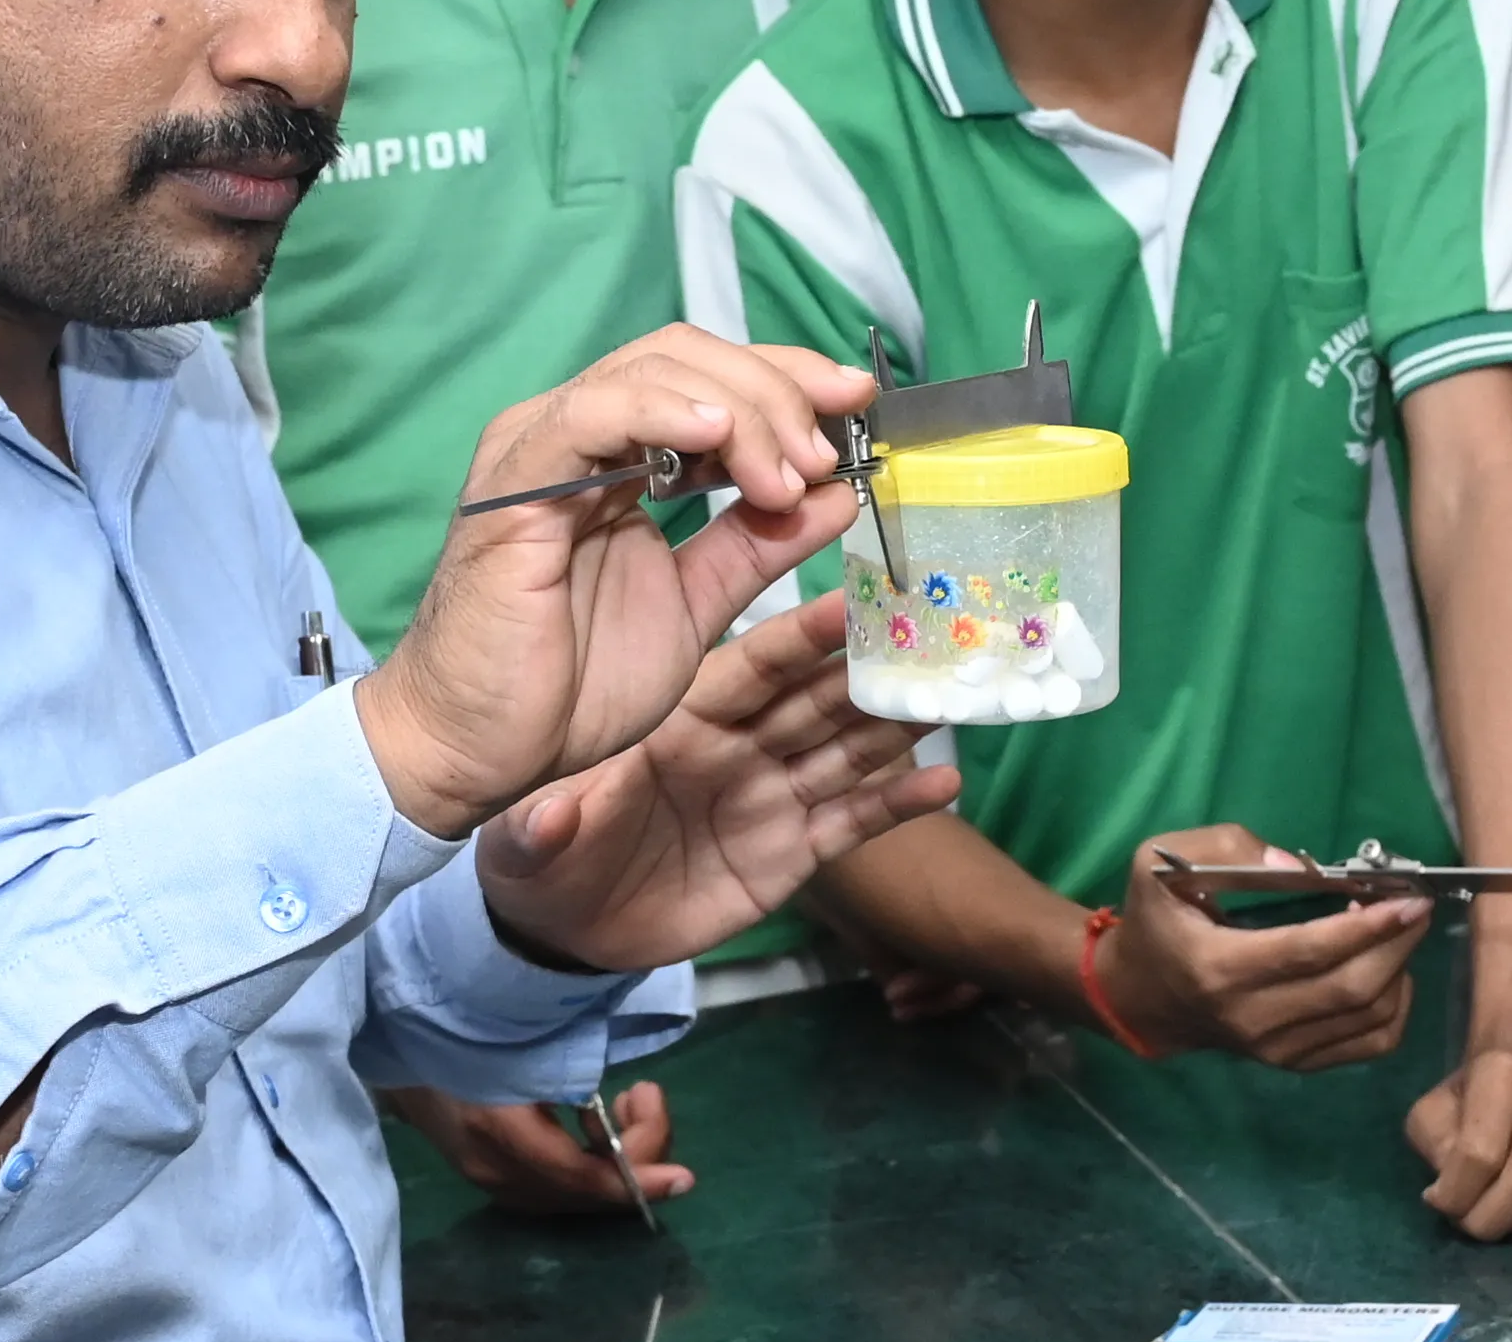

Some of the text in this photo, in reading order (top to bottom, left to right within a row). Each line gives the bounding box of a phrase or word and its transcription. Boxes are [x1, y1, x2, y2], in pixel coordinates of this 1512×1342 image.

[314, 126, 488, 184] MPION
[1207, 1305, 1440, 1315] OUTSIDE MICROMETERS
